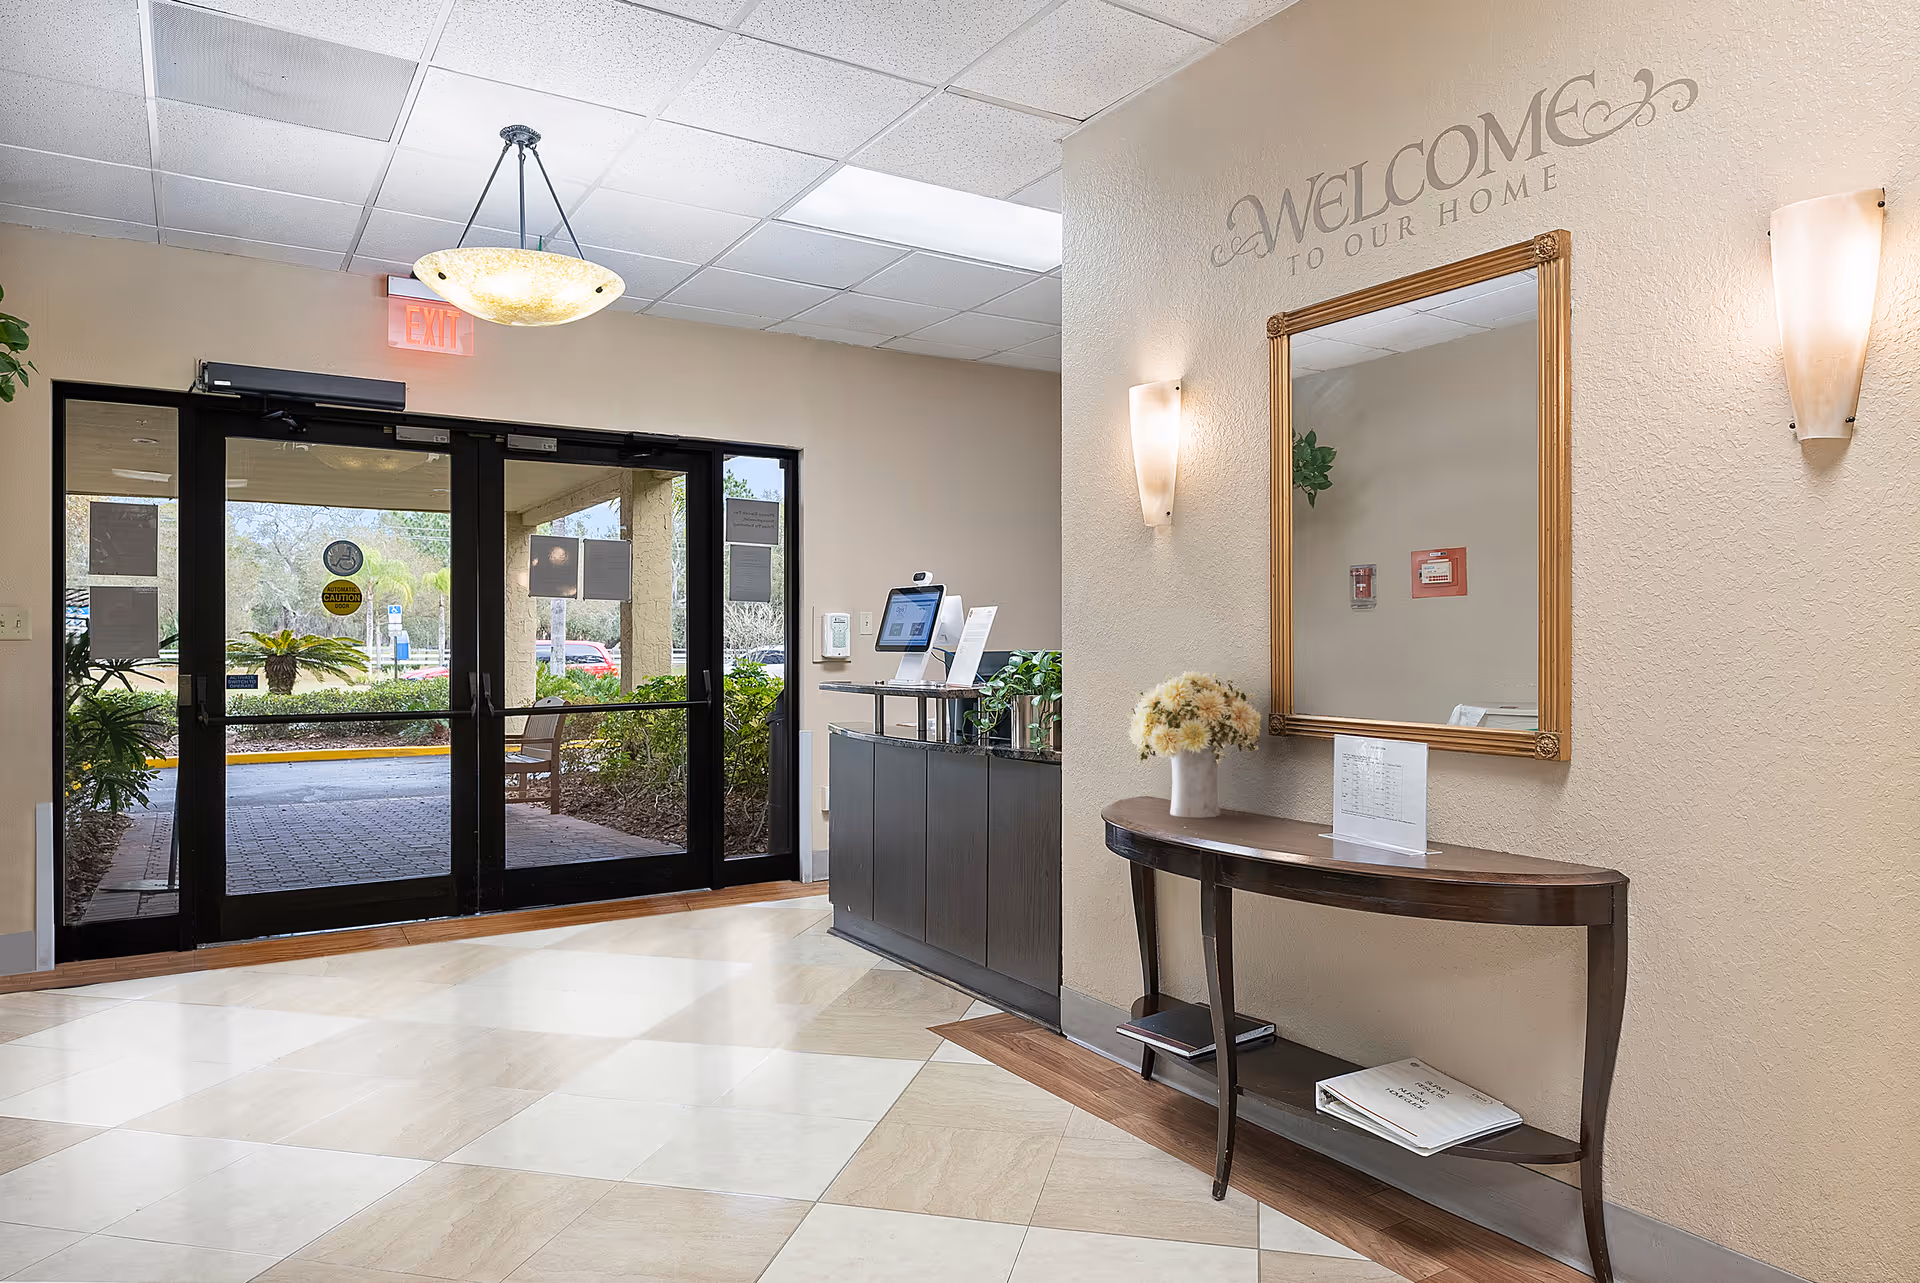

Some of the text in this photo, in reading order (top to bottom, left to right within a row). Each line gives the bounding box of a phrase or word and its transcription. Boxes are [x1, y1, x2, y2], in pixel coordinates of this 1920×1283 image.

[1211, 67, 1698, 267] WELCOME
[1287, 163, 1558, 276] TO OUR HOME
[405, 304, 461, 350] EXIT
[324, 594, 361, 602] CAUTION
[1398, 1087, 1430, 1105] NURSING
[1414, 1081, 1446, 1099] RESULTS
[1424, 1080, 1453, 1095] SURVEY
